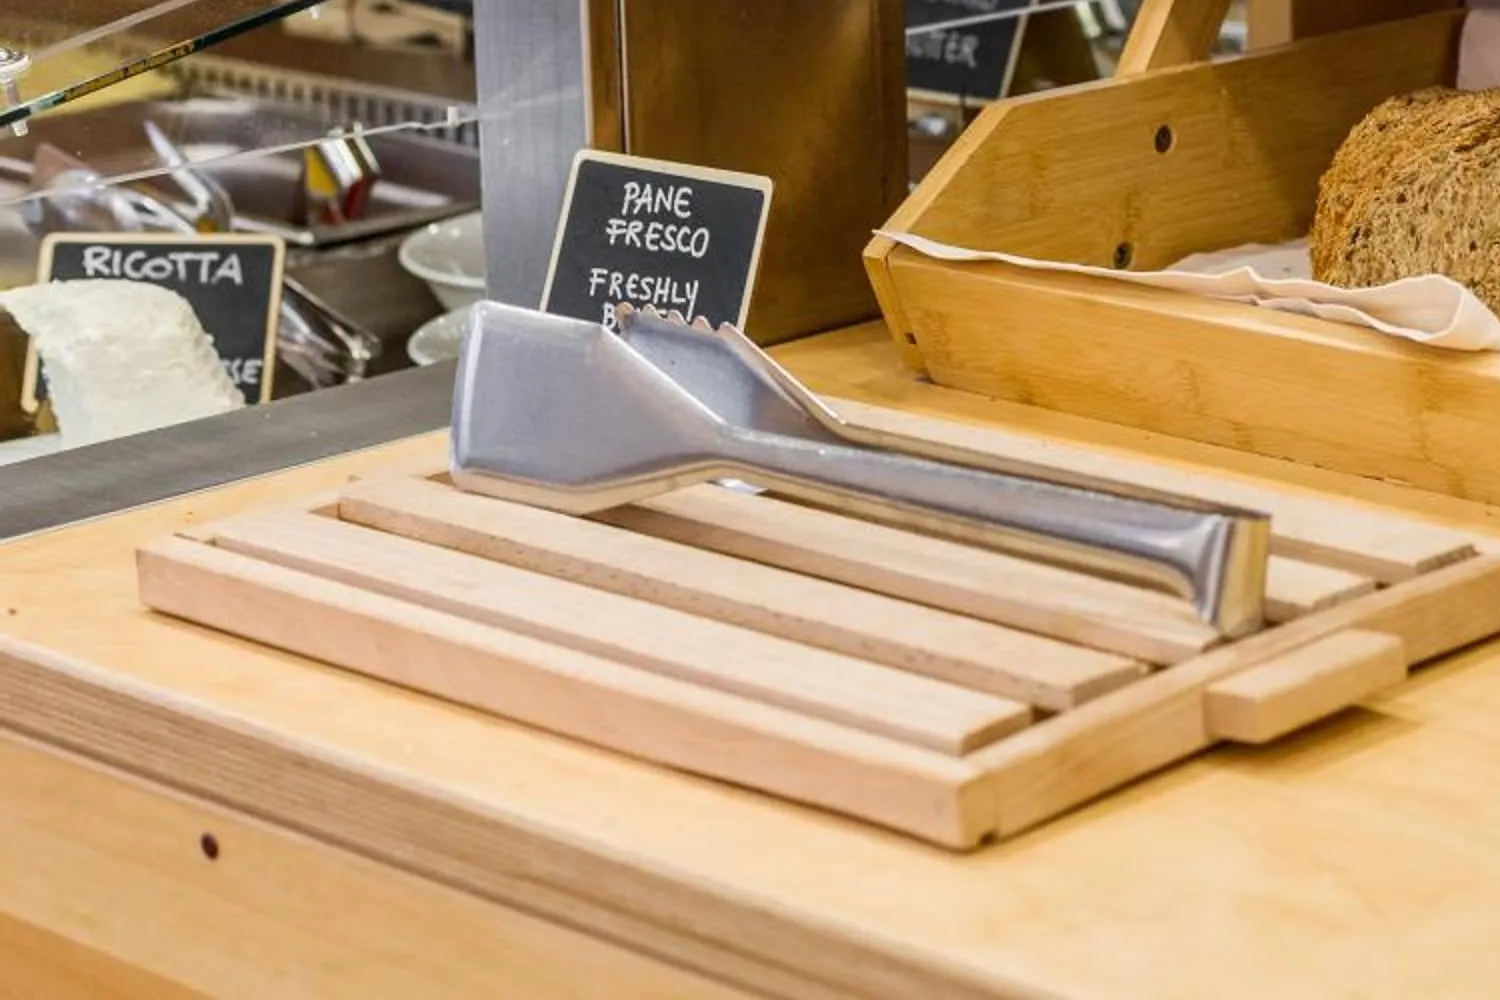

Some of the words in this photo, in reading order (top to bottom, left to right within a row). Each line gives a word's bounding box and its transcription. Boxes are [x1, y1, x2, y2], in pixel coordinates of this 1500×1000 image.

[621, 181, 694, 219] PANE
[605, 218, 710, 259] FRESCO
[82, 246, 243, 286] RICOTTA
[588, 267, 700, 323] FRESHLY
